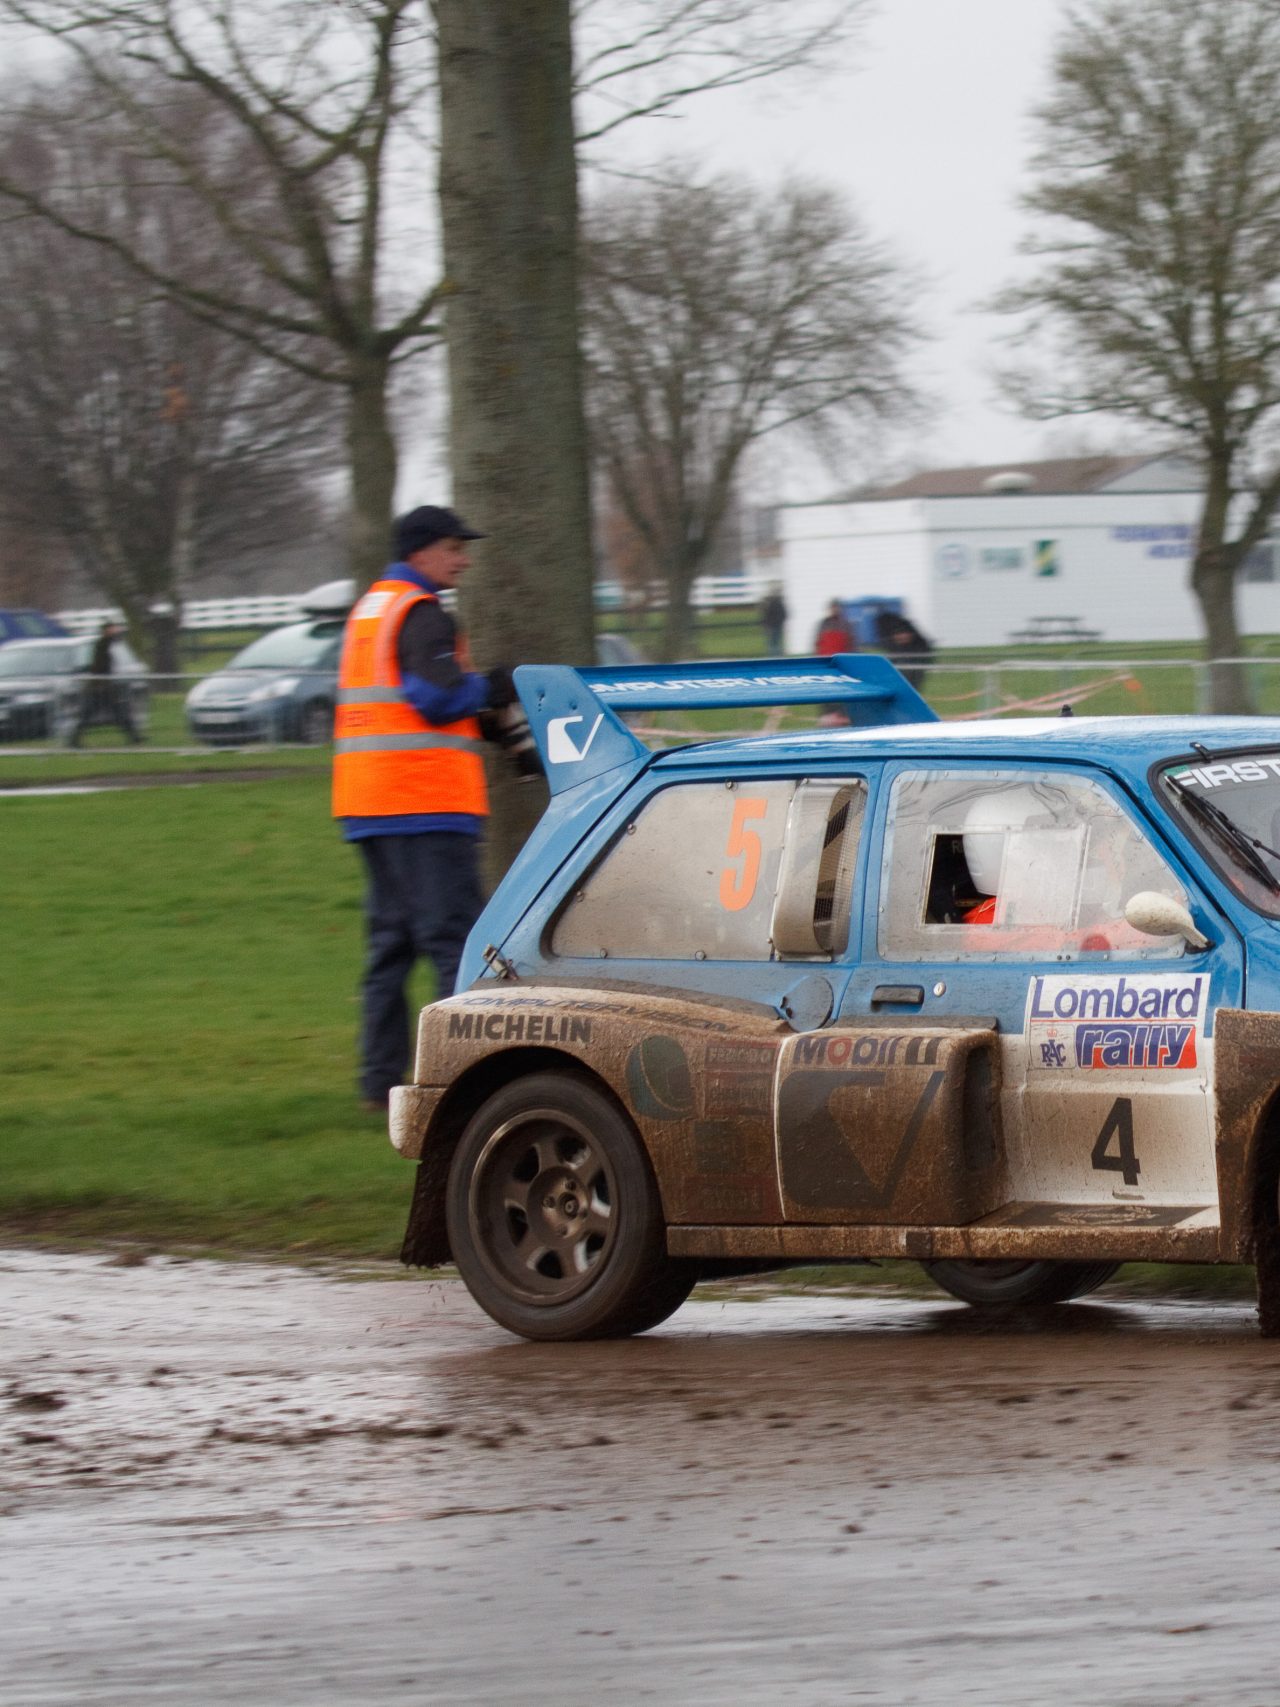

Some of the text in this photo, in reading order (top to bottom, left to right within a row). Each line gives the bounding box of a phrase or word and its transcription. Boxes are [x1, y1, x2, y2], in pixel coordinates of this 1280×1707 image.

[720, 797, 768, 912] 5
[1031, 977, 1203, 1019] Lombard
[450, 1013, 592, 1042] MICHELIN
[1080, 1024, 1192, 1069] rally
[1040, 1038, 1067, 1067] RAC
[1091, 1097, 1141, 1185] 4
